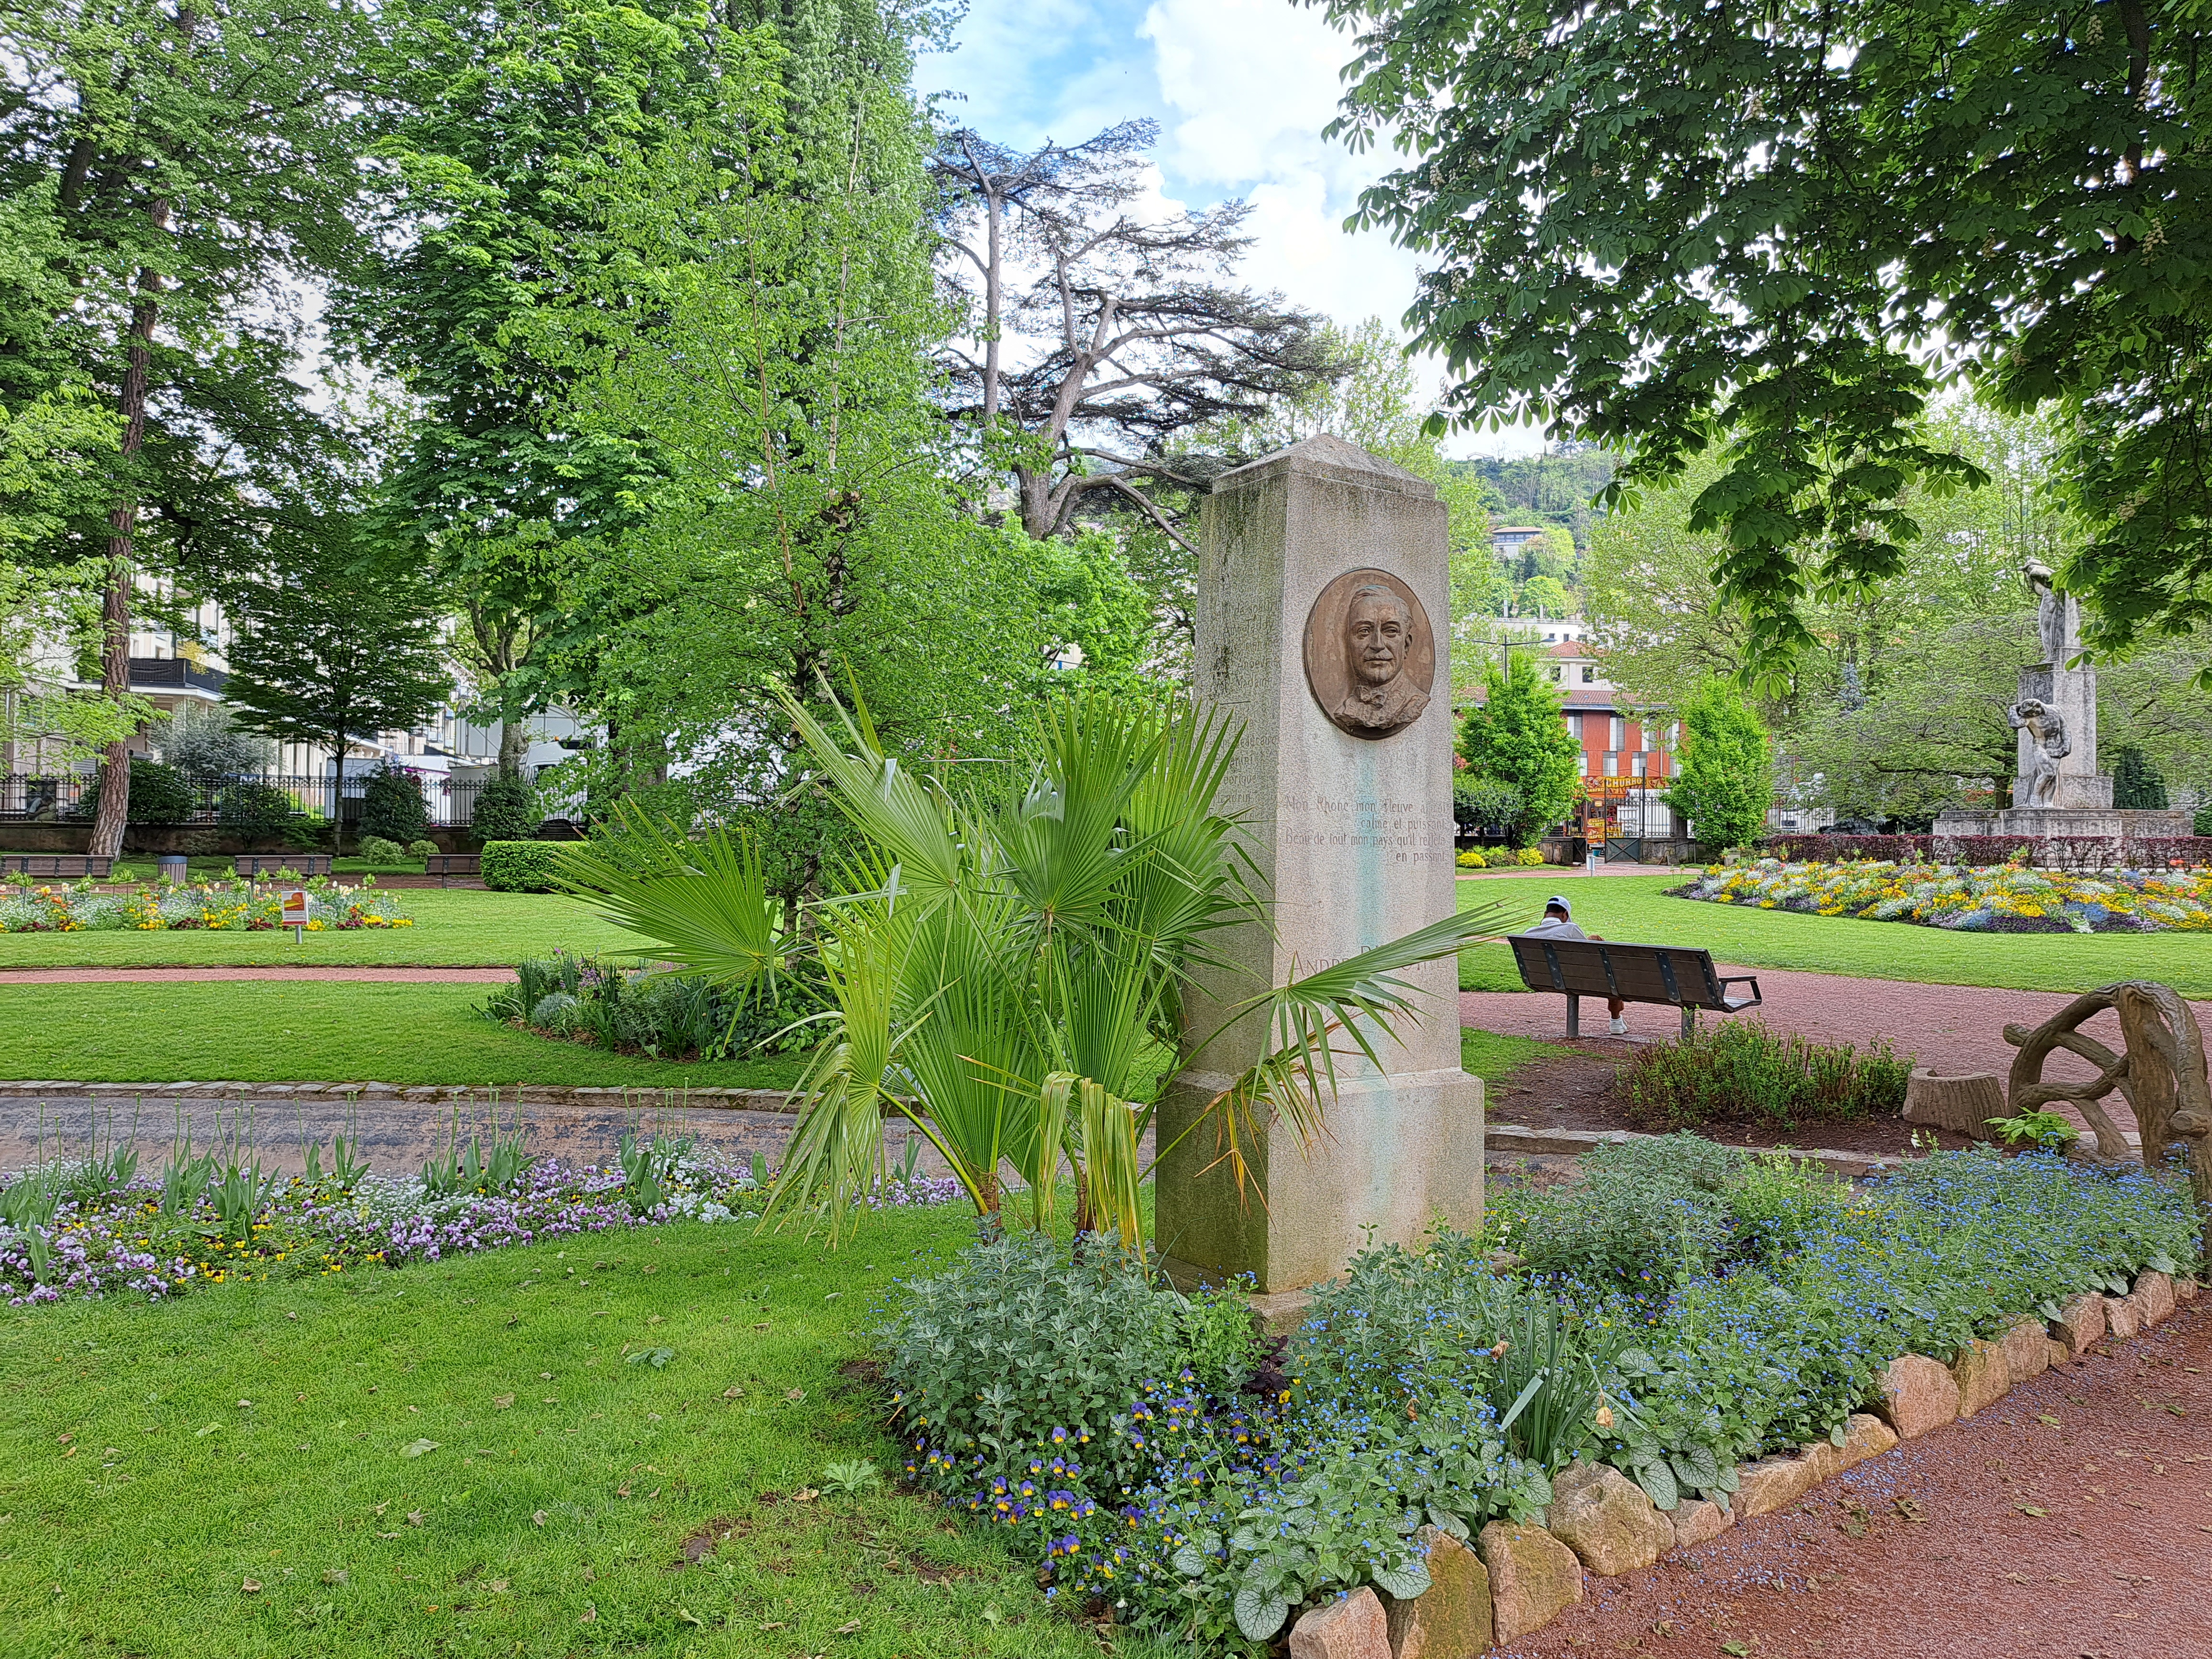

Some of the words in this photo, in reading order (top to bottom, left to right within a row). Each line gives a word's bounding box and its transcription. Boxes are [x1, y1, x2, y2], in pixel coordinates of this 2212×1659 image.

[1356, 801, 1376, 813] mon
[1383, 798, 1413, 813] fleuve
[1360, 814, 1388, 829] calme
[1394, 818, 1402, 829] et
[1407, 818, 1445, 833] puissant
[1314, 831, 1325, 845] de
[1330, 832, 1347, 845] tout
[1350, 835, 1368, 845] mon
[1372, 835, 1393, 849] pays
[1397, 832, 1415, 848] qu'il
[1396, 852, 1407, 863] en
[1413, 852, 1445, 864] passant
[1287, 950, 1350, 977] ANDR
